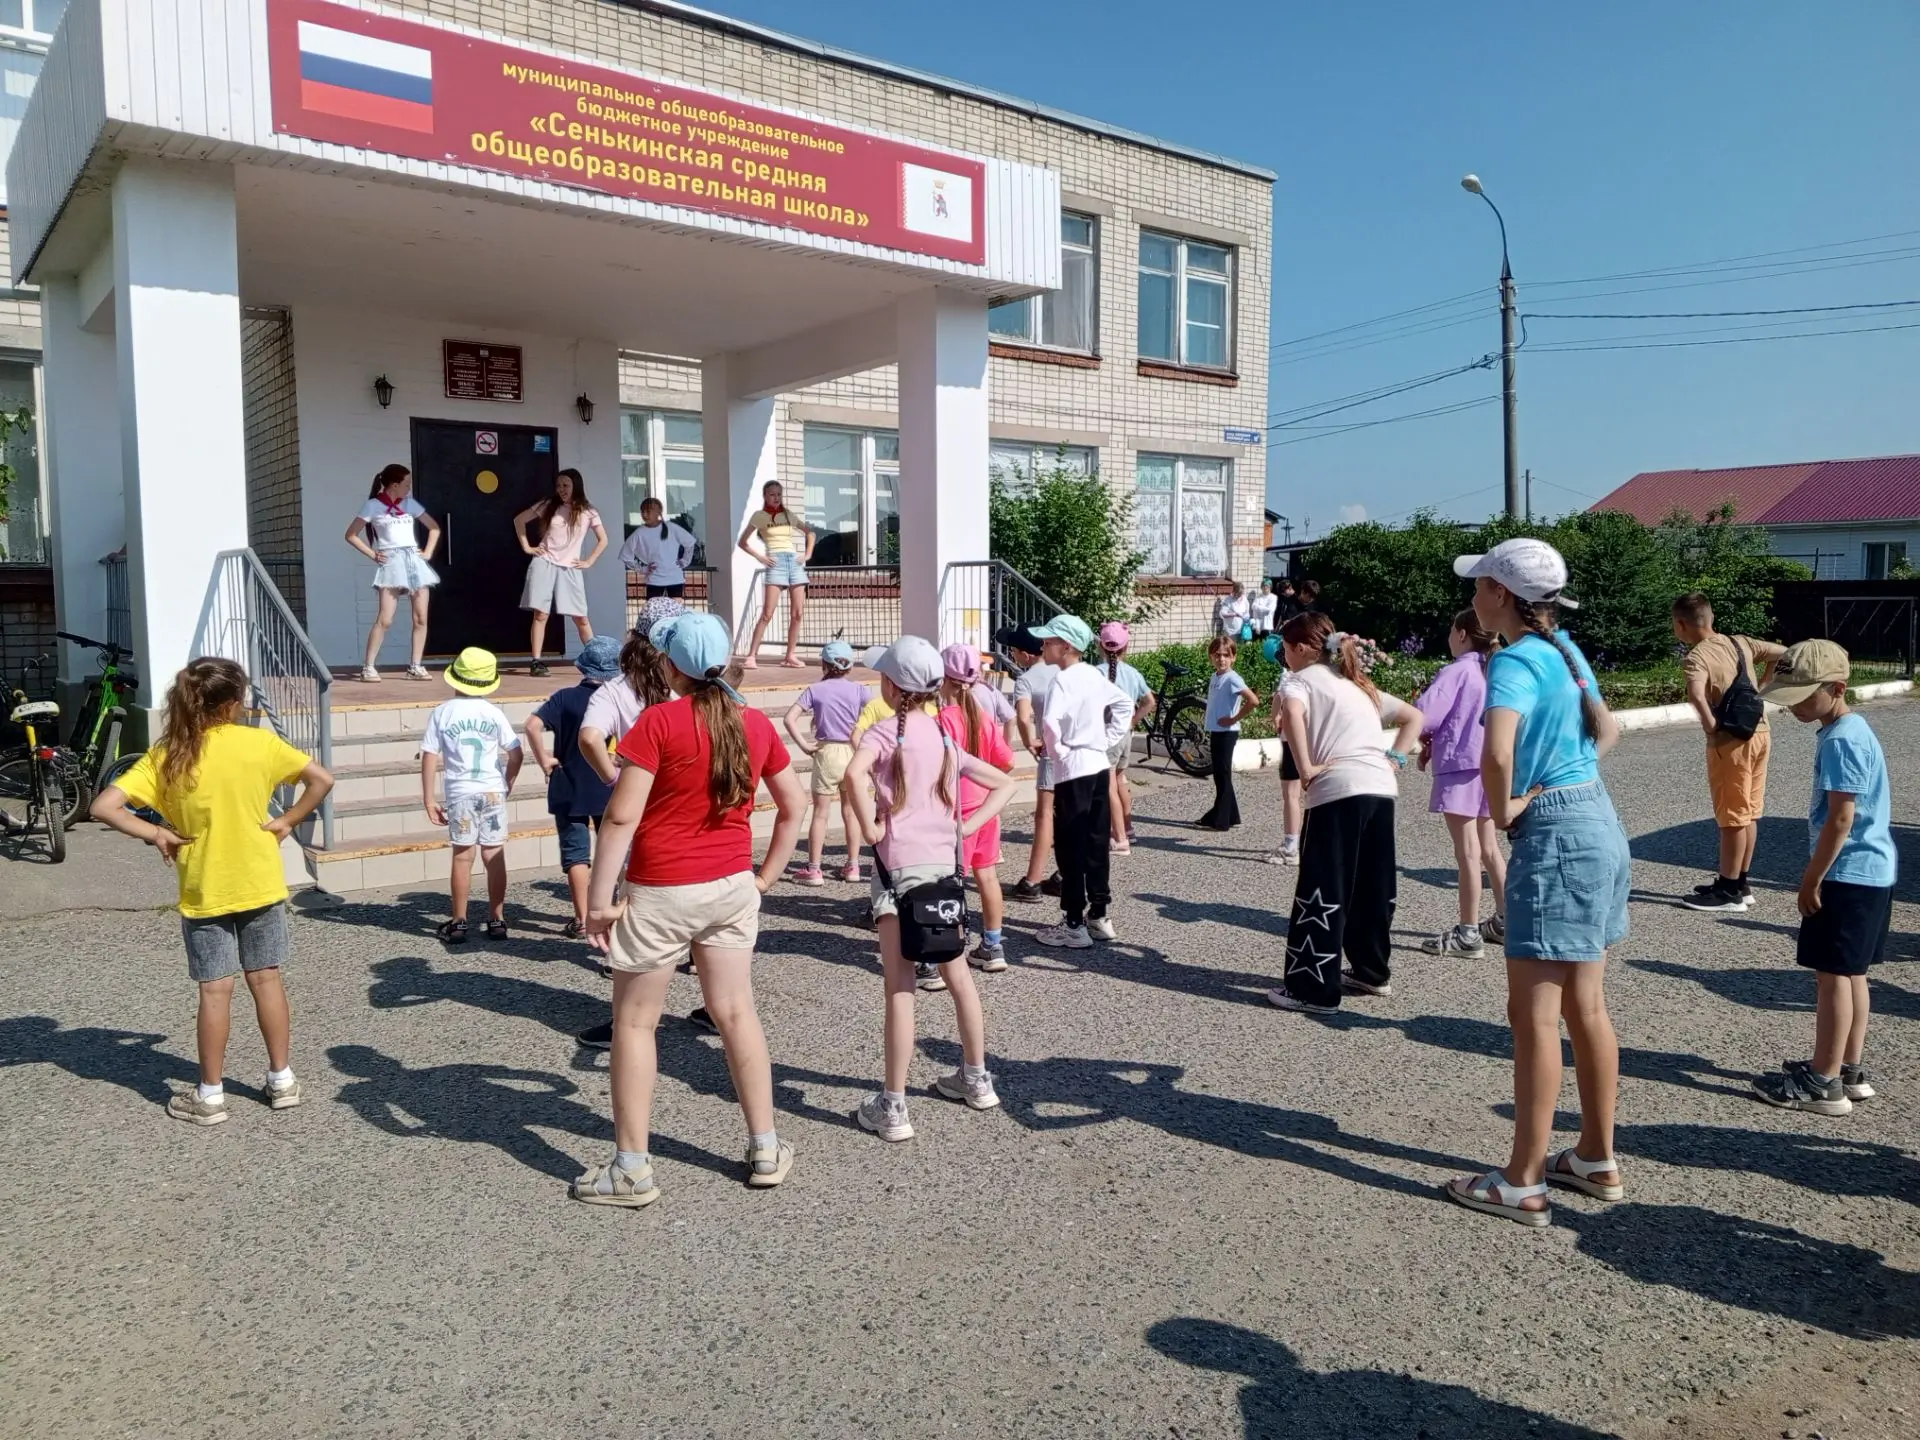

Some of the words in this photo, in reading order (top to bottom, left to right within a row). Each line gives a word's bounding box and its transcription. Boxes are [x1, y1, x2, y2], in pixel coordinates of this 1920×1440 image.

[503, 63, 655, 110] муниципальное
[661, 100, 845, 154] общеобразовательное
[576, 96, 682, 135] бюджетное
[687, 125, 789, 160] учреждение
[471, 131, 776, 210] общеобразовательная
[783, 195, 869, 227] школа»
[530, 112, 724, 171] «Сенькинская
[731, 156, 827, 193] средняя
[444, 718, 496, 740] RONALDO
[460, 737, 483, 779] 7
